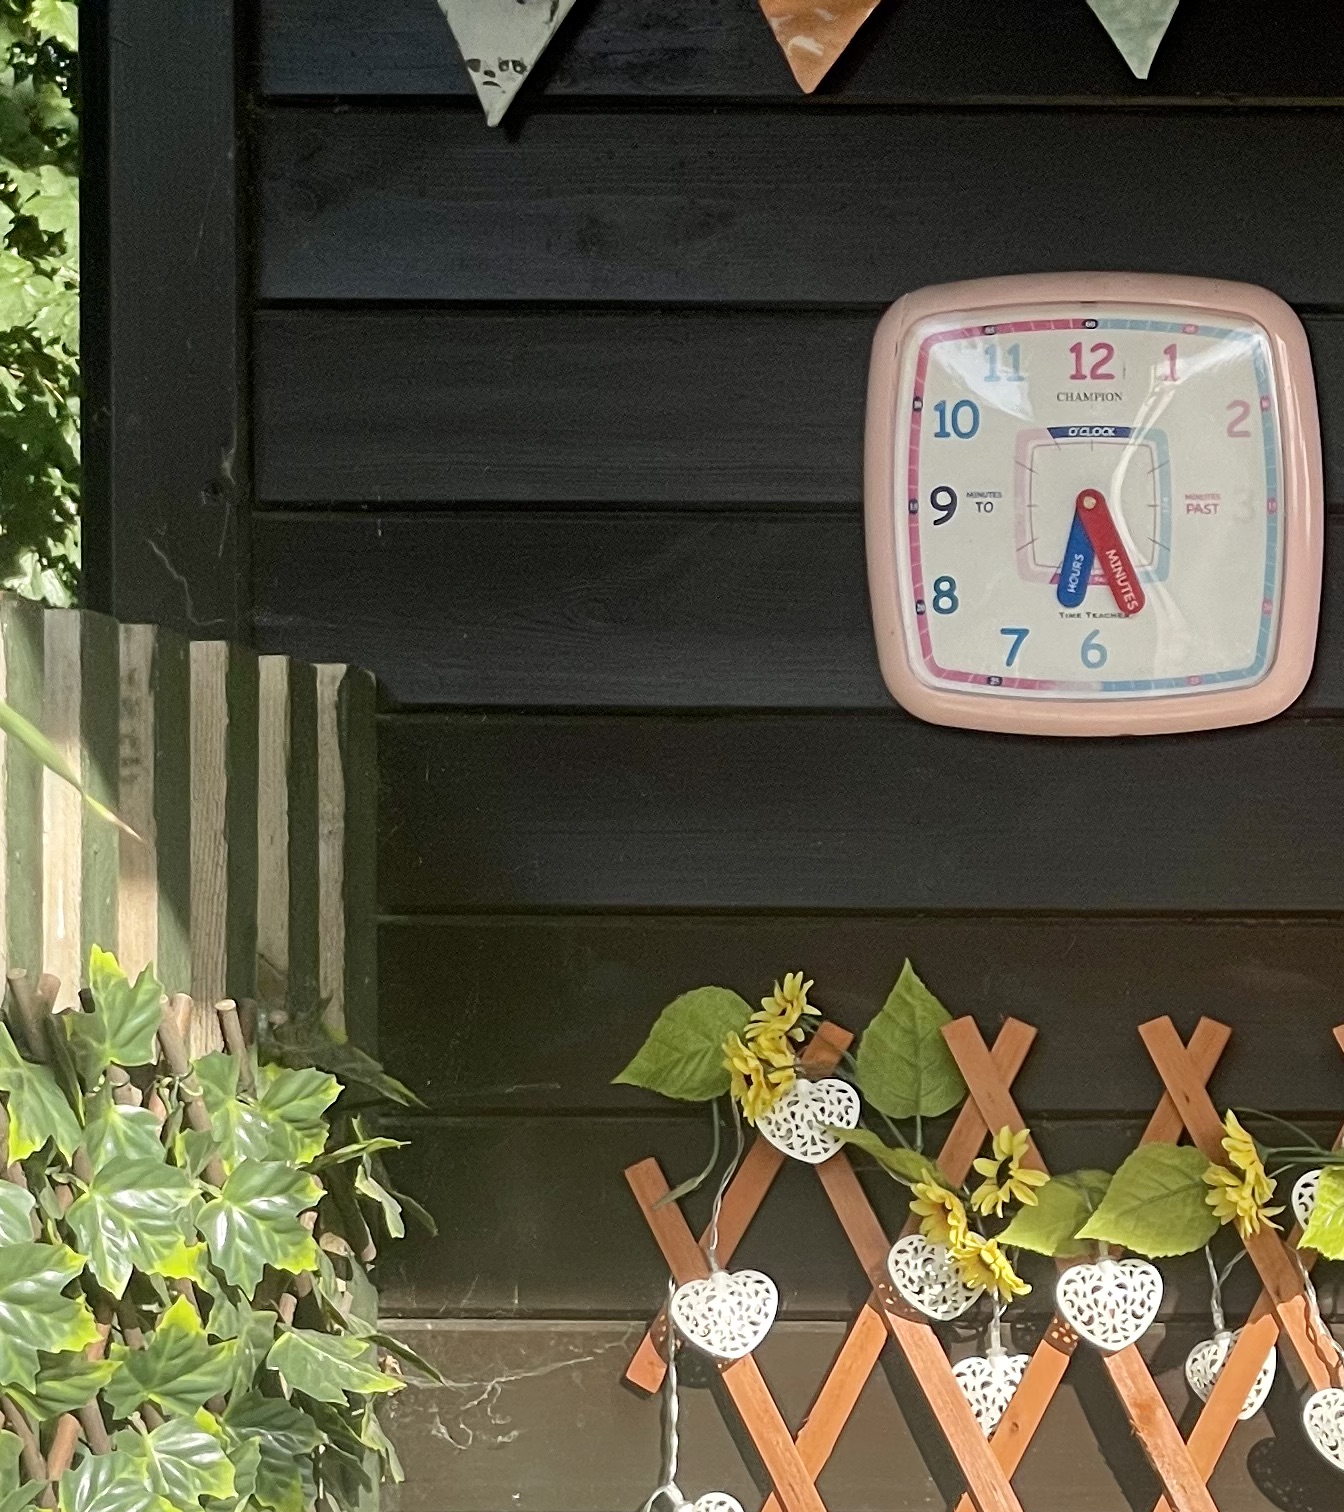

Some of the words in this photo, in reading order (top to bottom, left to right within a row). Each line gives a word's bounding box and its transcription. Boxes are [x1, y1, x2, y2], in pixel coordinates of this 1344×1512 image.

[983, 343, 1025, 382] 11
[1069, 342, 1116, 380] 12
[1163, 343, 1180, 381] 1
[1056, 391, 1123, 402] CHAMPION
[934, 399, 981, 439] 10
[1068, 427, 1116, 437] O'CLOCK
[1226, 400, 1251, 438] 2
[930, 486, 958, 526] 9
[975, 502, 994, 513] TO
[1186, 503, 1219, 514] PAST
[1067, 553, 1084, 593] HOURS
[1105, 549, 1139, 611] MINUTES
[932, 575, 959, 615] 8
[1000, 627, 1030, 667] 7
[1080, 629, 1108, 669] 6
